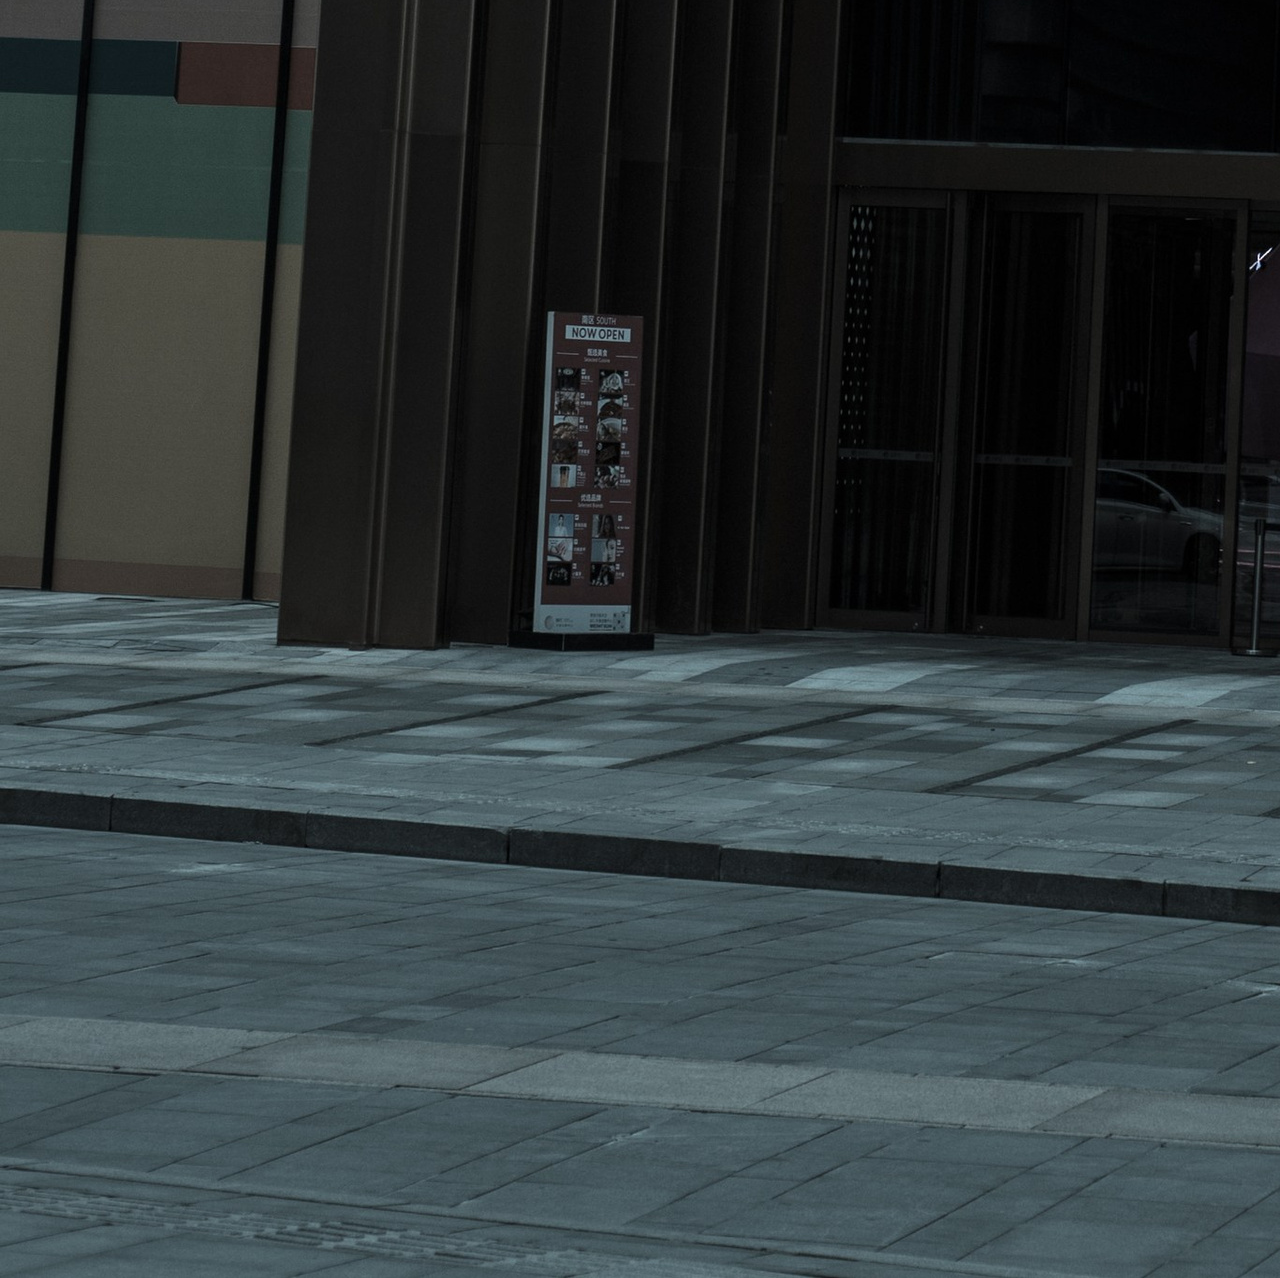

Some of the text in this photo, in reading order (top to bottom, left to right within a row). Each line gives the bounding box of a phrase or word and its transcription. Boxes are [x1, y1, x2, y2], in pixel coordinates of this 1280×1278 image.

[581, 315, 617, 325] 南区 SOUTH
[572, 327, 625, 340] NOW OPEN
